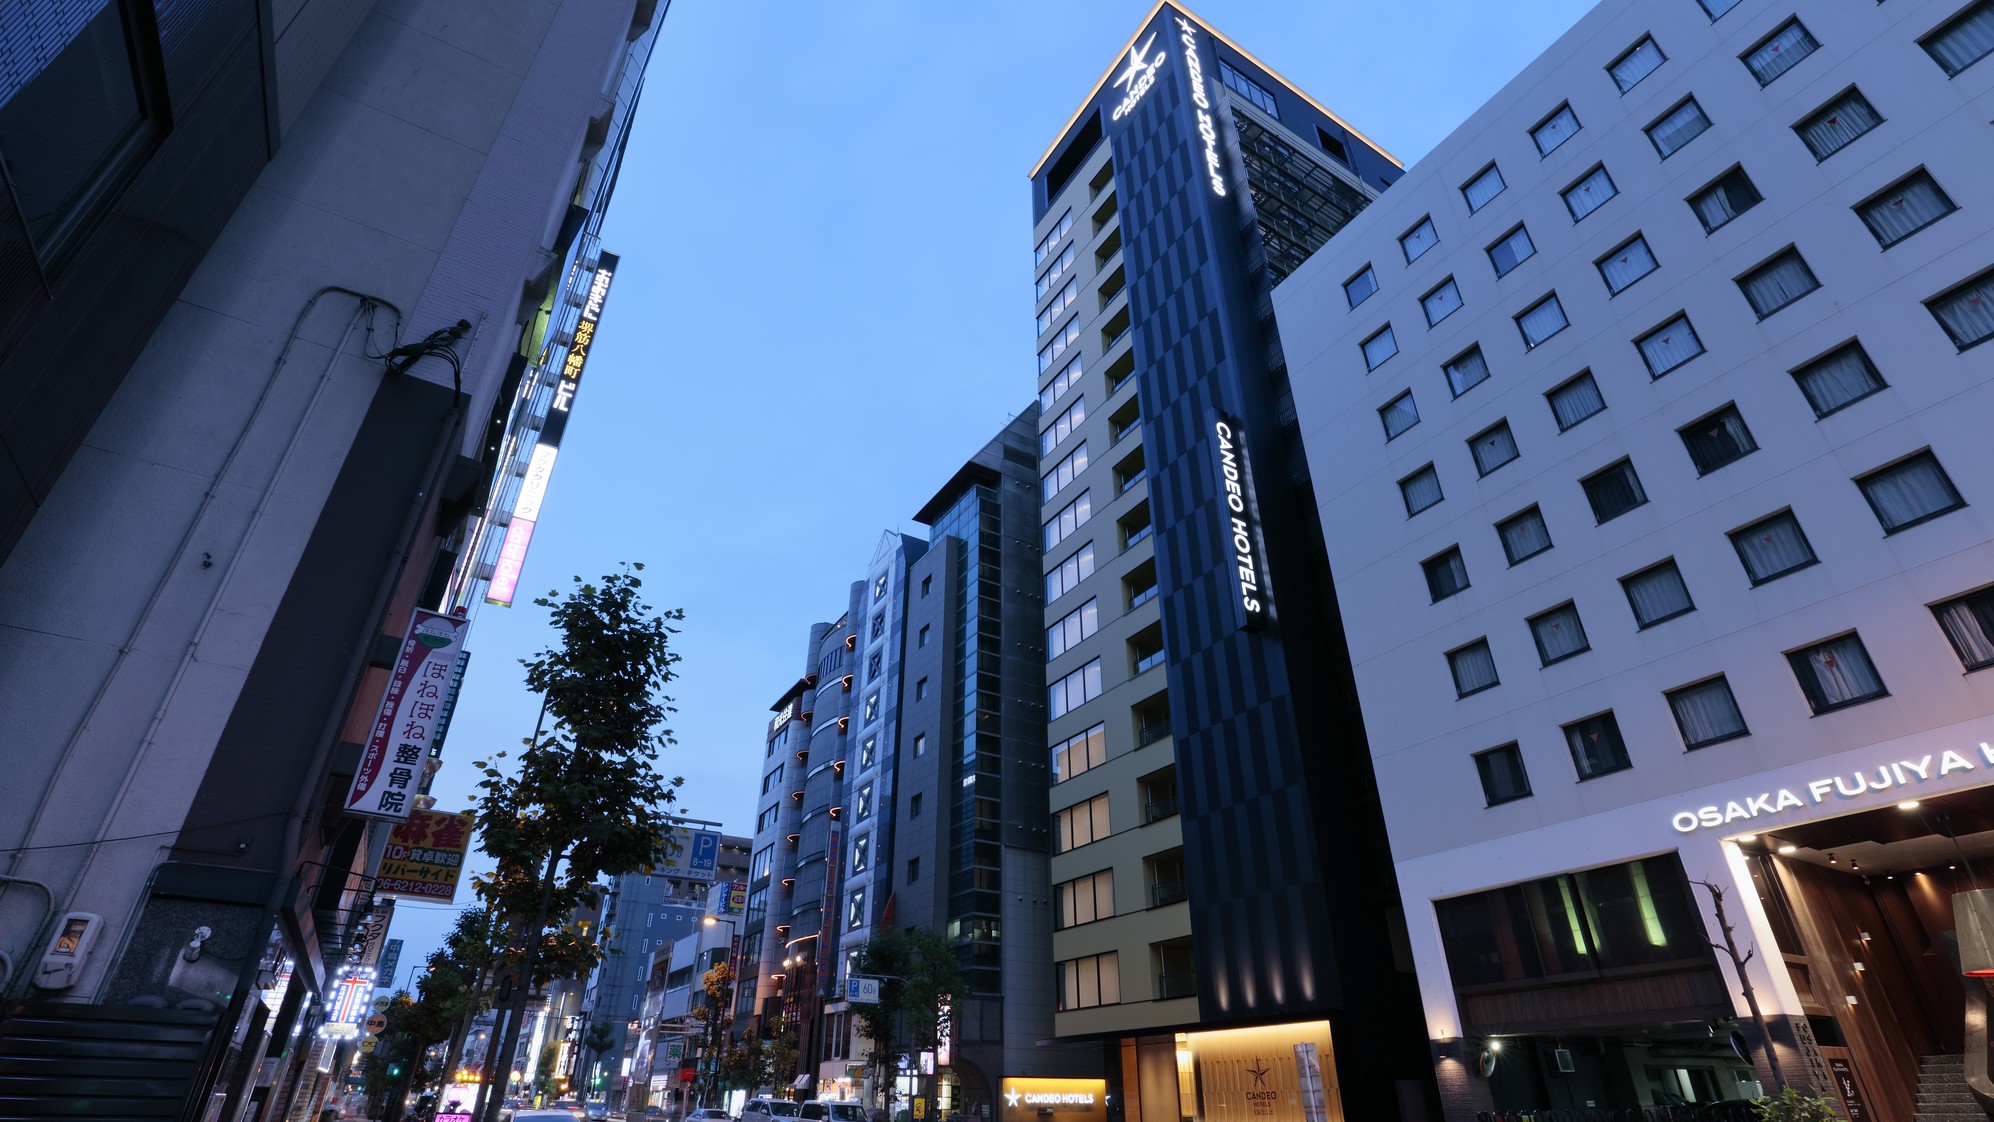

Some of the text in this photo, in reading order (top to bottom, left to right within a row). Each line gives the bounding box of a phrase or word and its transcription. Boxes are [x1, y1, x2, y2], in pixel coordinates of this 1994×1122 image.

[1112, 51, 1166, 121] CANDEO
[1124, 76, 1155, 116] HOTELS
[1181, 34, 1226, 197] CANDEO HOTELS
[1215, 421, 1261, 613] CANDEO HOTELS
[377, 661, 448, 813] ほねほね整骨院
[1672, 789, 1805, 833] OSAKA
[1808, 750, 1975, 803] FUJIYA
[392, 808, 468, 849] 麻雀
[699, 836, 713, 856] P
[382, 862, 456, 882] リバーサイド
[851, 980, 858, 990] P
[367, 1019, 385, 1029] 中島
[668, 1044, 682, 1059] 薬
[1024, 1092, 1095, 1104] CANDEO HOTELS
[1245, 1091, 1277, 1101] CANDEO
